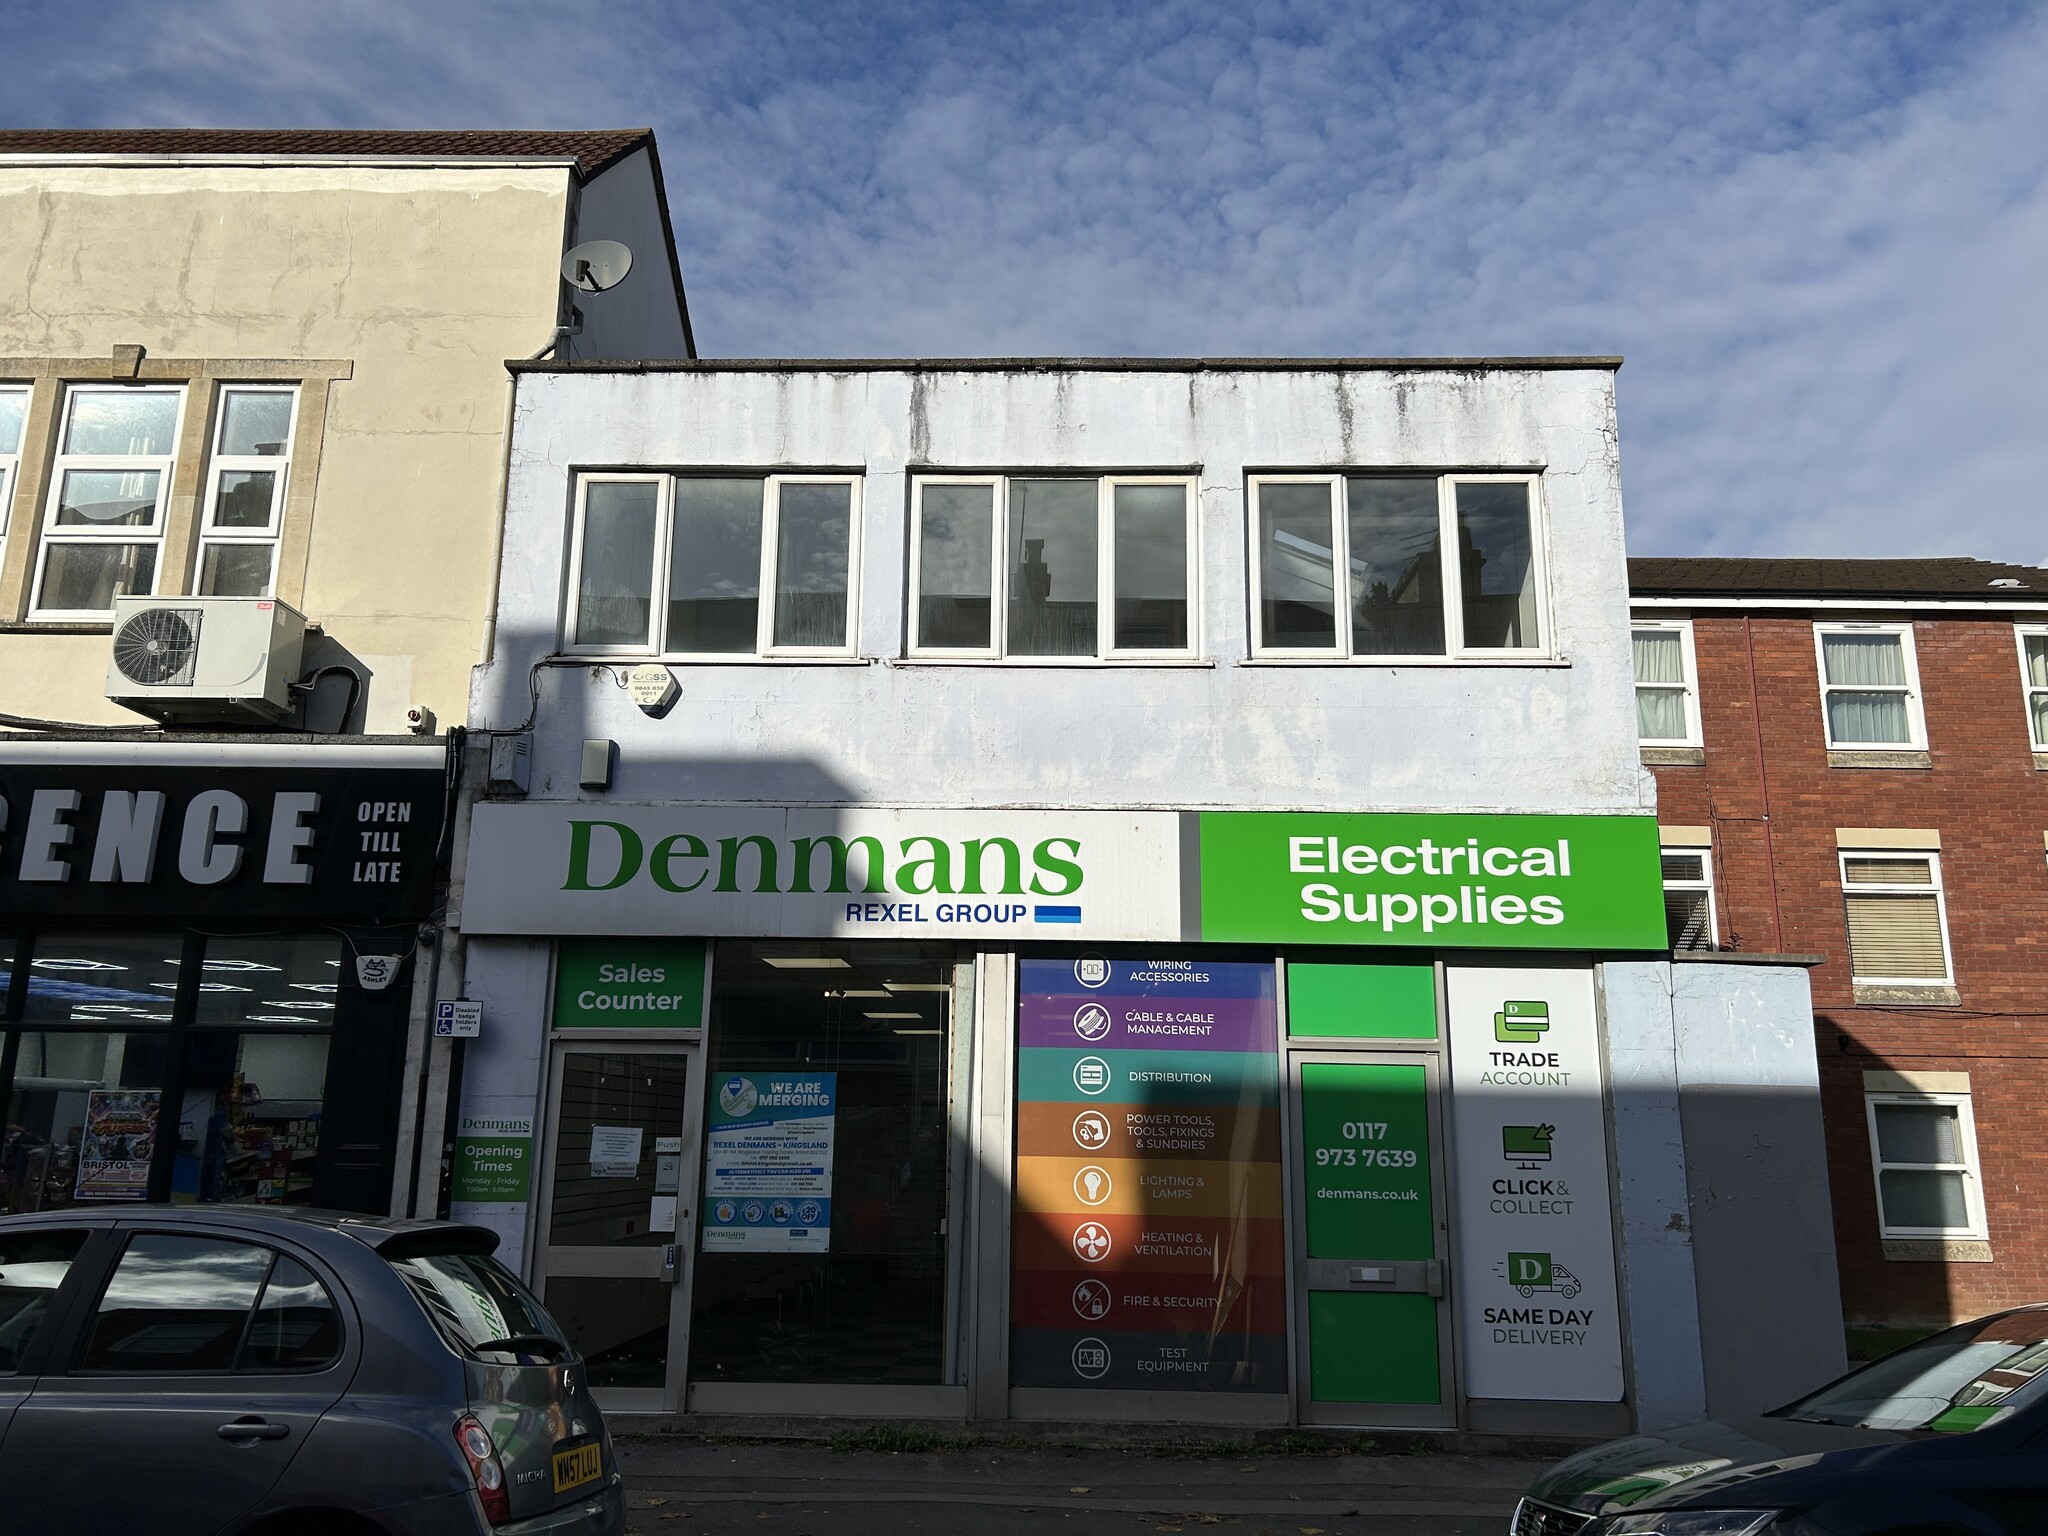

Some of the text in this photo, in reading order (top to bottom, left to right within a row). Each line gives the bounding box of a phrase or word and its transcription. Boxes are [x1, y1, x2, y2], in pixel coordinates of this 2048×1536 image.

[357, 801, 411, 823] OPEN
[361, 831, 402, 853] TILL
[560, 820, 1084, 895] Denmans
[1288, 836, 1571, 876] Electrical
[353, 861, 402, 883] LATE
[846, 903, 1027, 924] REXEL GROUP
[1300, 883, 1564, 933] Supplies
[1147, 960, 1192, 970] WIRING
[362, 975, 388, 983] ASHLEY
[598, 963, 666, 984] Sales
[1130, 972, 1210, 983] ACCESSORIES
[577, 990, 683, 1011] Counter
[442, 1004, 452, 1016] P
[1125, 1012, 1215, 1023] CABLE & CABLE
[1127, 1024, 1212, 1036] MANAGEMENT
[1489, 1052, 1560, 1067] TRADE
[1129, 1072, 1212, 1083] DISTRIBUTION
[1480, 1071, 1571, 1086] ACCOUNT
[770, 1082, 821, 1094] WE ARE
[759, 1094, 830, 1106] MERGING
[462, 1118, 530, 1130] Denmans
[1126, 1114, 1215, 1126] POWER TOOLS,
[1127, 1126, 1215, 1138] TOOLS, FIXINGS
[1342, 1122, 1388, 1140] 0117
[657, 1141, 680, 1149] Push
[1136, 1139, 1206, 1150] & SUNDRIES
[464, 1145, 522, 1159] Opening
[1315, 1149, 1417, 1168] 973 7639
[83, 1161, 130, 1170] BRISTOL
[472, 1160, 513, 1172] Times
[497, 1178, 520, 1186] Friday
[1140, 1176, 1205, 1186] LIGHTING &
[1317, 1187, 1419, 1200] denmans.co.uk
[1492, 1179, 1570, 1196] CLICK &
[1152, 1189, 1193, 1199] LAMPS
[1489, 1200, 1574, 1215] COLLECT
[1141, 1232, 1203, 1243] HEATING &
[1135, 1245, 1212, 1256] VENTILATION
[1519, 1259, 1543, 1281] D
[1123, 1296, 1221, 1308] FIRE & SECURITY
[1484, 1308, 1594, 1326] SAME DAY
[1493, 1328, 1586, 1345] DELIVERY
[1159, 1347, 1187, 1358] TEST
[1137, 1360, 1209, 1372] EQUIPMENT
[581, 1447, 598, 1477] LUJ
[516, 1469, 546, 1485] MICRA
